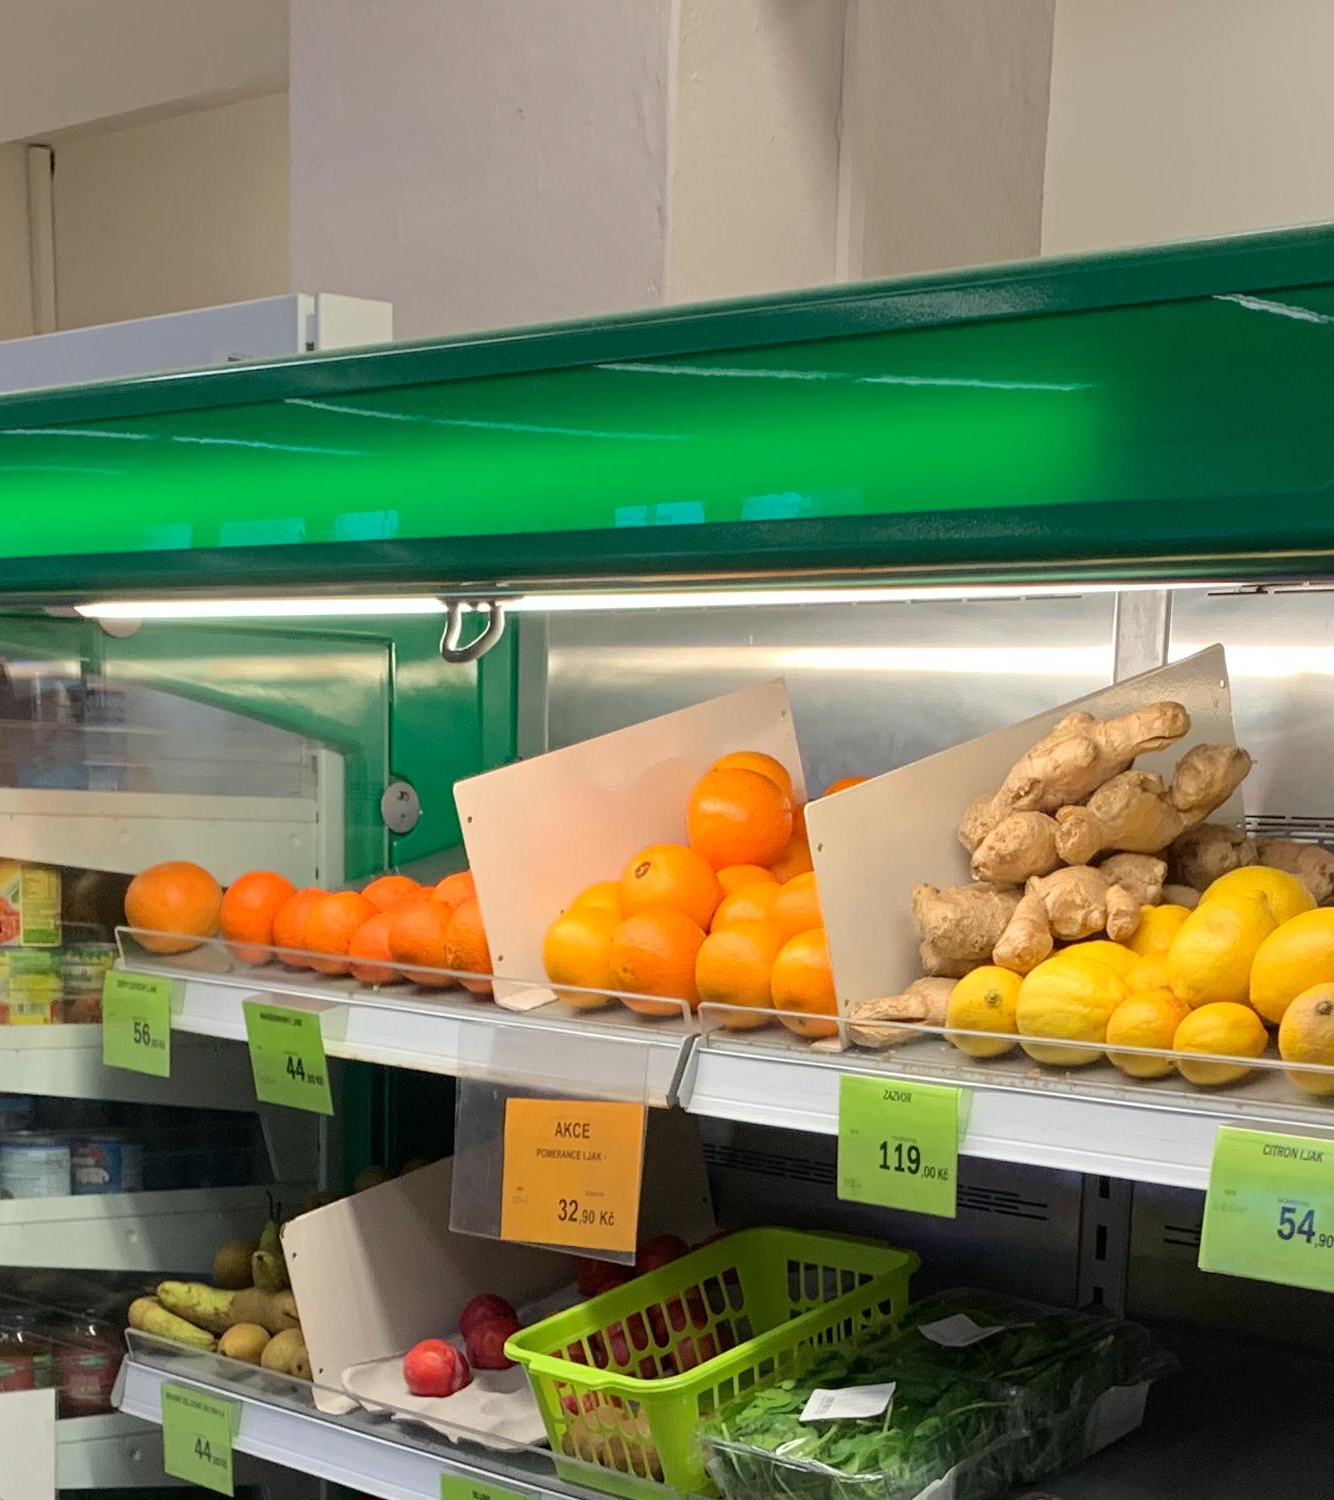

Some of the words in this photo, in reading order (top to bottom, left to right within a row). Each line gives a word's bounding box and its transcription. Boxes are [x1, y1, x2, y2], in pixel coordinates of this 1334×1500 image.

[882, 1089, 912, 1103] ZAZVOR
[555, 1121, 590, 1139] AKCE
[536, 1148, 581, 1161] POMERANCE
[1262, 1143, 1298, 1159] CITRON
[879, 1140, 937, 1180] 119,00
[938, 1167, 949, 1181] Kč
[558, 1198, 595, 1225] 32,90
[600, 1211, 615, 1227] Kč
[1276, 1206, 1334, 1249] 54,90
